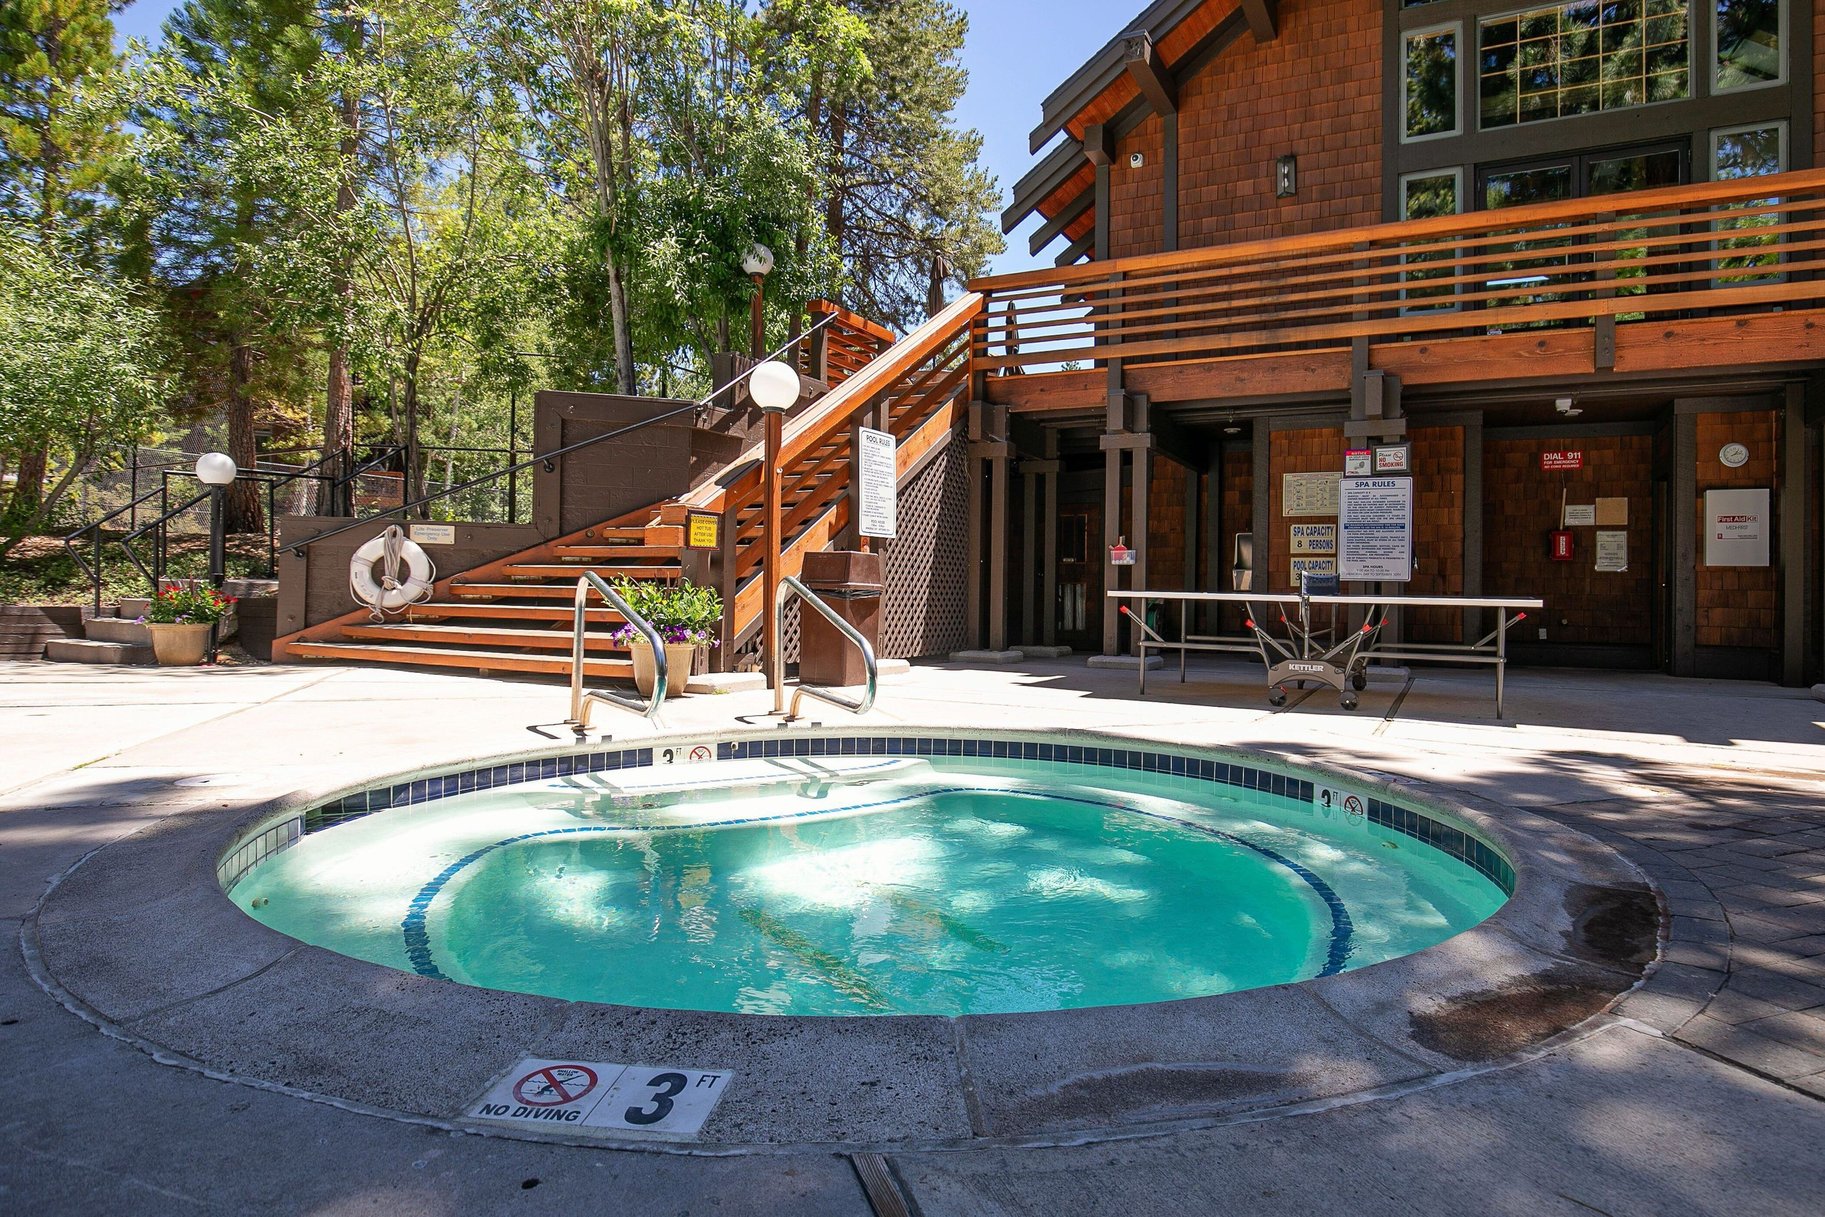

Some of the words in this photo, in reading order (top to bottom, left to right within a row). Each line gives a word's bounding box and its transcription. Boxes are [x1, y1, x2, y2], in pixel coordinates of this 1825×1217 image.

[1543, 452, 1564, 460] DIAL
[1567, 452, 1581, 460] 911
[1378, 461, 1404, 469] SMOKING
[1293, 526, 1304, 536] SPA
[1306, 526, 1334, 536] CAPACITY
[1308, 540, 1334, 550] PERSONS
[1293, 560, 1307, 570] POOL
[1308, 560, 1334, 570] CAPACITY
[1288, 664, 1324, 672] KETTLER
[676, 748, 682, 756] FT
[1332, 791, 1338, 800] FT
[624, 1072, 688, 1126] 3
[696, 1074, 722, 1089] FT
[478, 1103, 510, 1116] NO
[511, 1106, 581, 1122] DIVING
